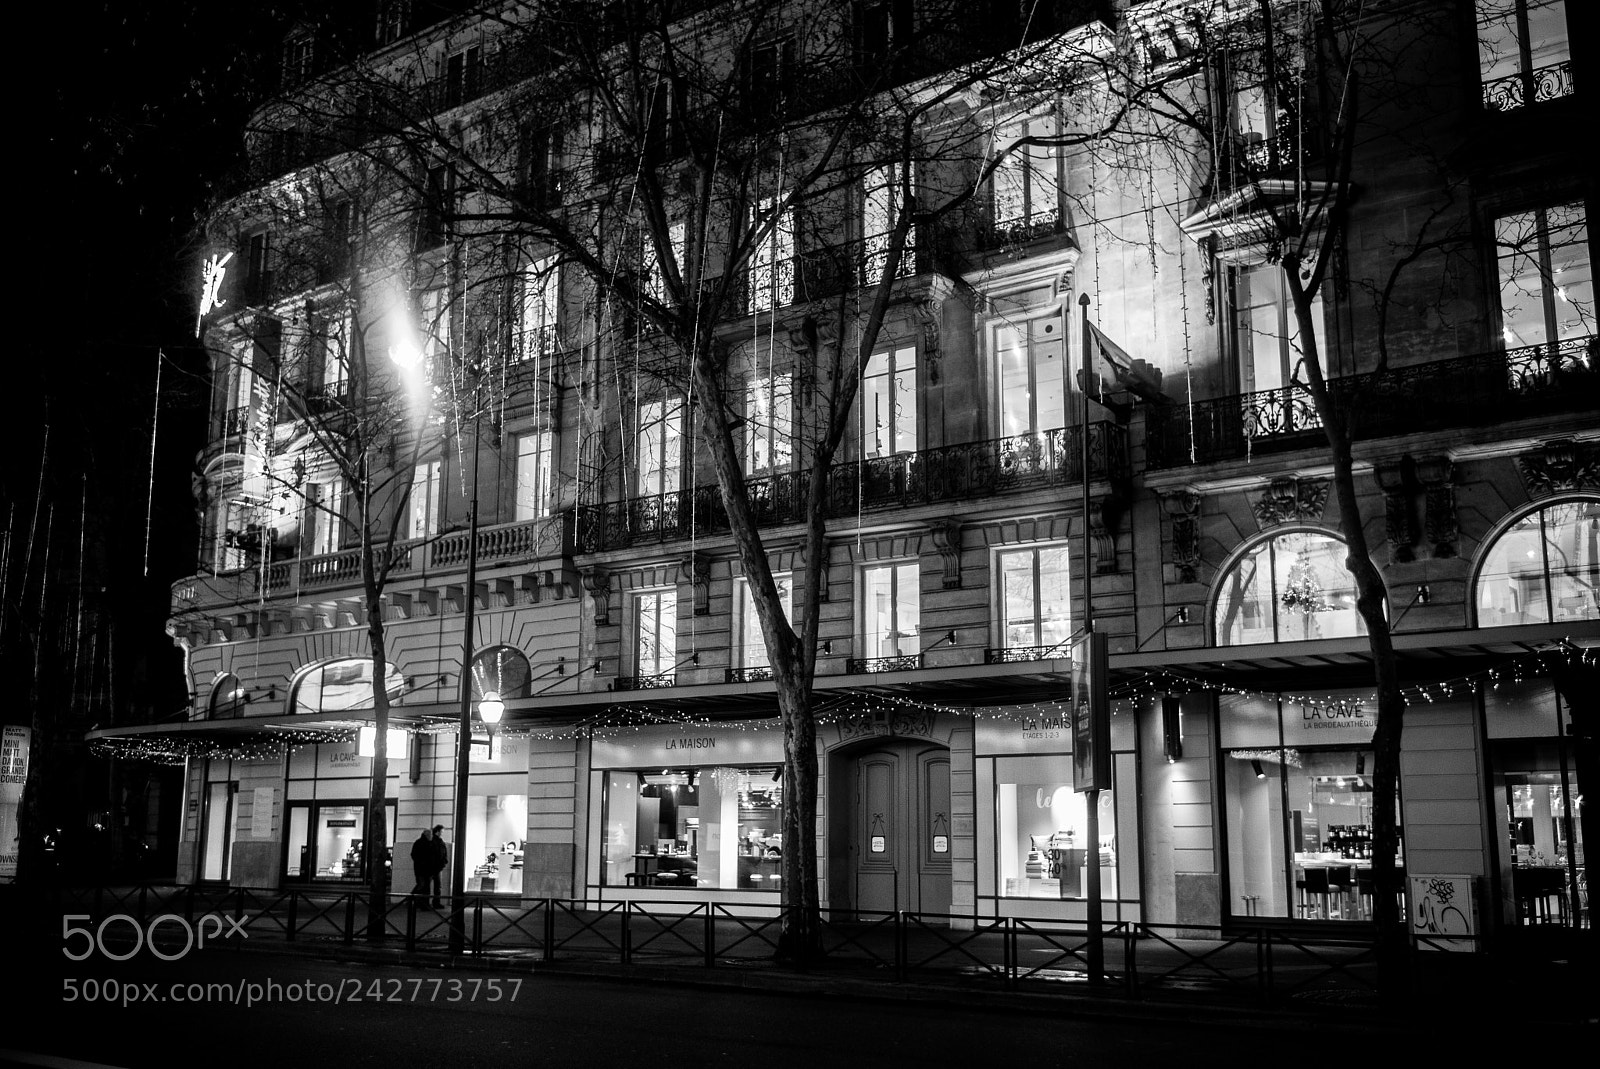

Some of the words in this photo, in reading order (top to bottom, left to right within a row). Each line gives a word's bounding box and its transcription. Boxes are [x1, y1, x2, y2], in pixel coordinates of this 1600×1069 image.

[1303, 707, 1321, 720] LA
[1325, 704, 1364, 719] CAVE
[1022, 719, 1037, 731] LA
[1303, 722, 1312, 730] LA
[3, 739, 20, 748] MINI
[665, 738, 677, 750] LA
[679, 737, 716, 749] MAISON
[330, 753, 338, 763] LA
[339, 752, 356, 762] CAVE
